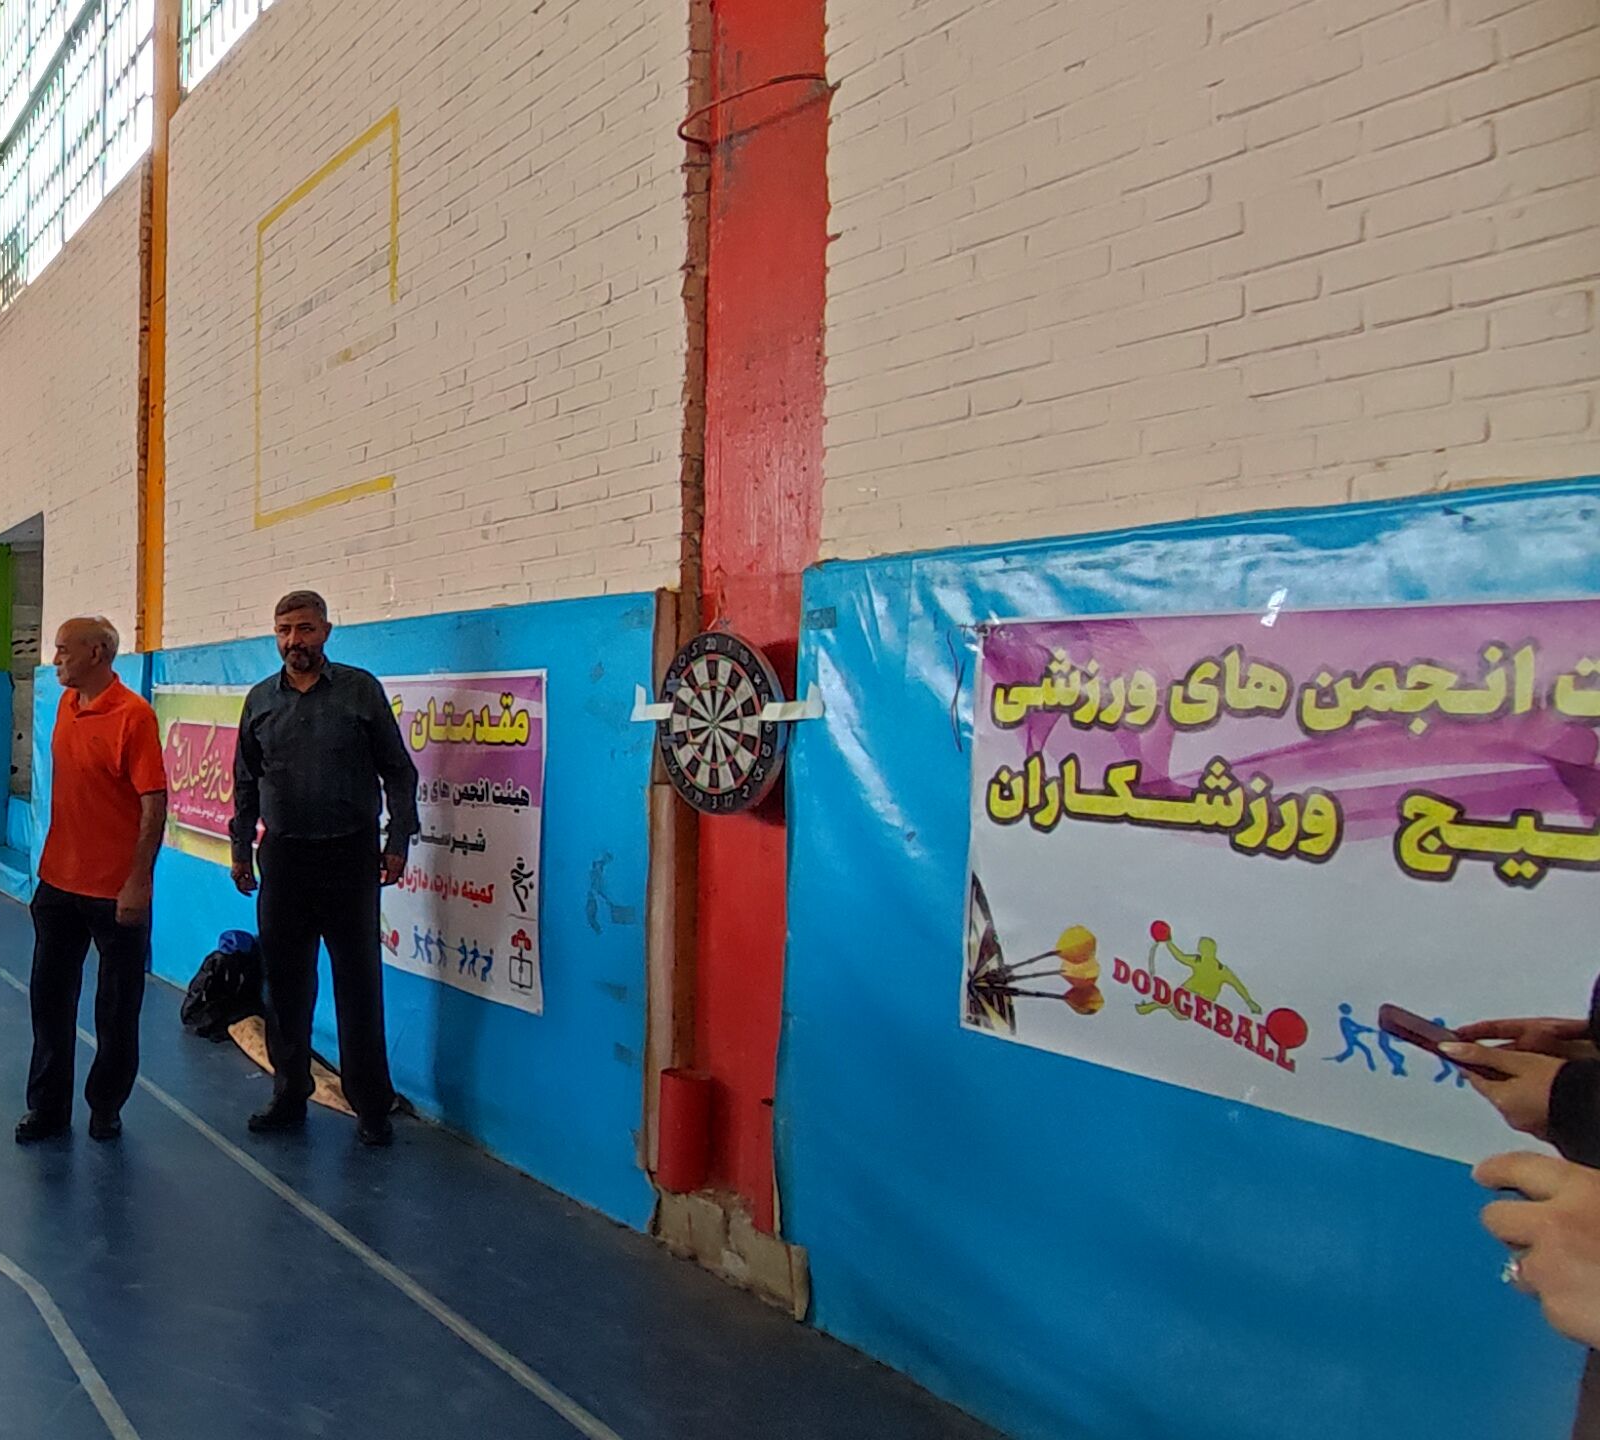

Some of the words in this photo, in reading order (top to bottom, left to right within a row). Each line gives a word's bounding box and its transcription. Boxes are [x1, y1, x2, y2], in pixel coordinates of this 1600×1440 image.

[691, 642, 699, 657] 5
[705, 637, 717, 650] 20
[727, 639, 733, 651] 1
[753, 672, 762, 686] 4
[993, 648, 1159, 726] ورزشی
[1167, 646, 1290, 727] های
[1299, 641, 1537, 737] انجمن
[410, 692, 531, 752] مقدمتان
[764, 722, 773, 733] 6
[761, 743, 772, 757] 10
[753, 765, 764, 781] 15
[431, 776, 450, 803] های
[453, 778, 490, 809] انجمن
[492, 778, 530, 813] هیئت
[741, 784, 750, 798] 2
[711, 795, 718, 809] 3
[723, 794, 734, 808] 17
[987, 753, 1339, 859] ورزشکاران
[1112, 957, 1296, 1073] DODGEBALL
